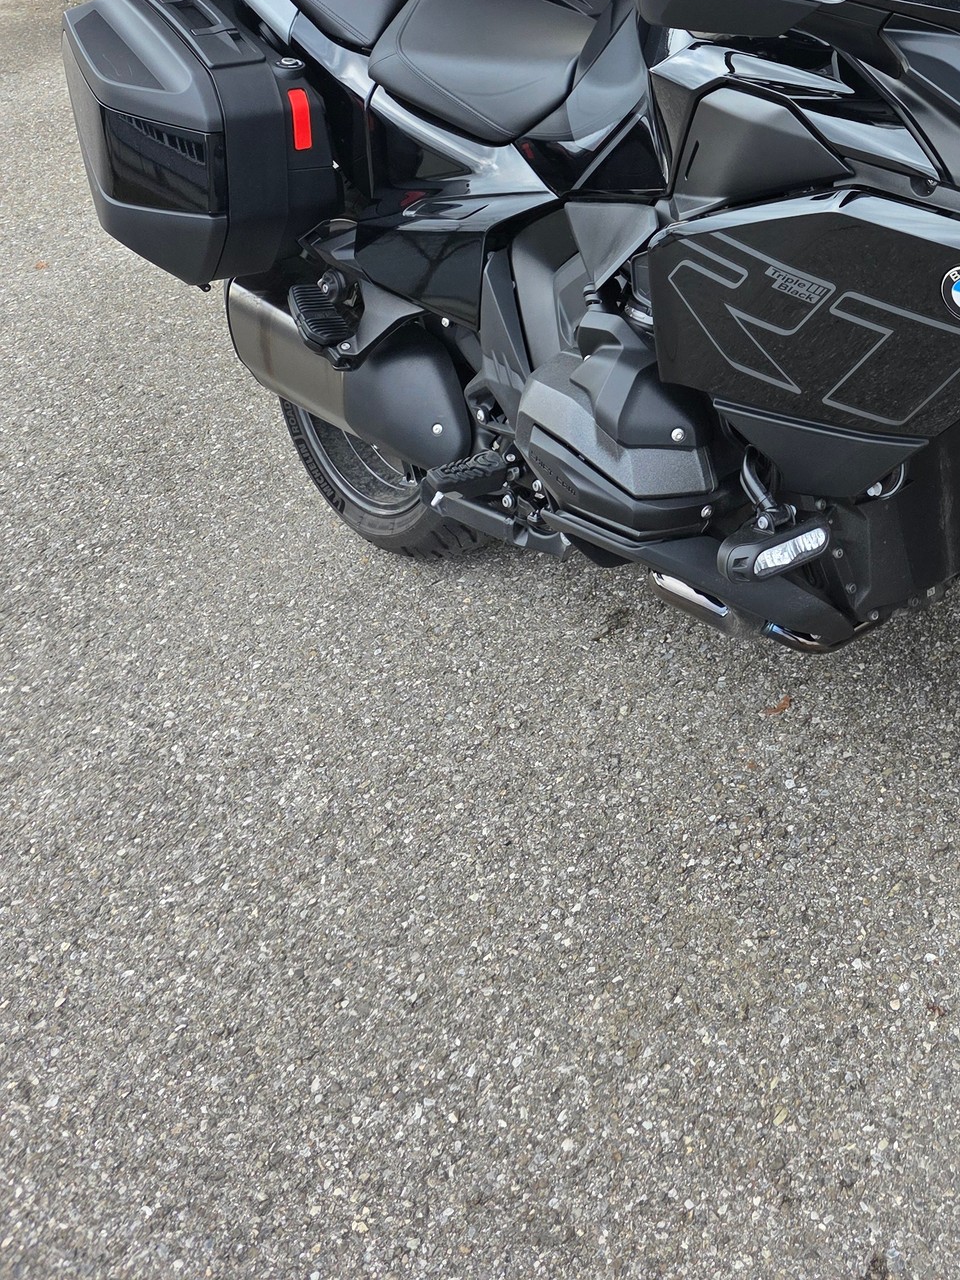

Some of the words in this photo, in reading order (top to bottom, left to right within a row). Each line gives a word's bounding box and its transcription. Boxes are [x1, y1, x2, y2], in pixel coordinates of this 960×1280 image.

[771, 268, 806, 288] Triple
[777, 282, 815, 302] Black
[283, 401, 300, 436] ROAD
[298, 442, 335, 498] MICHELIN
